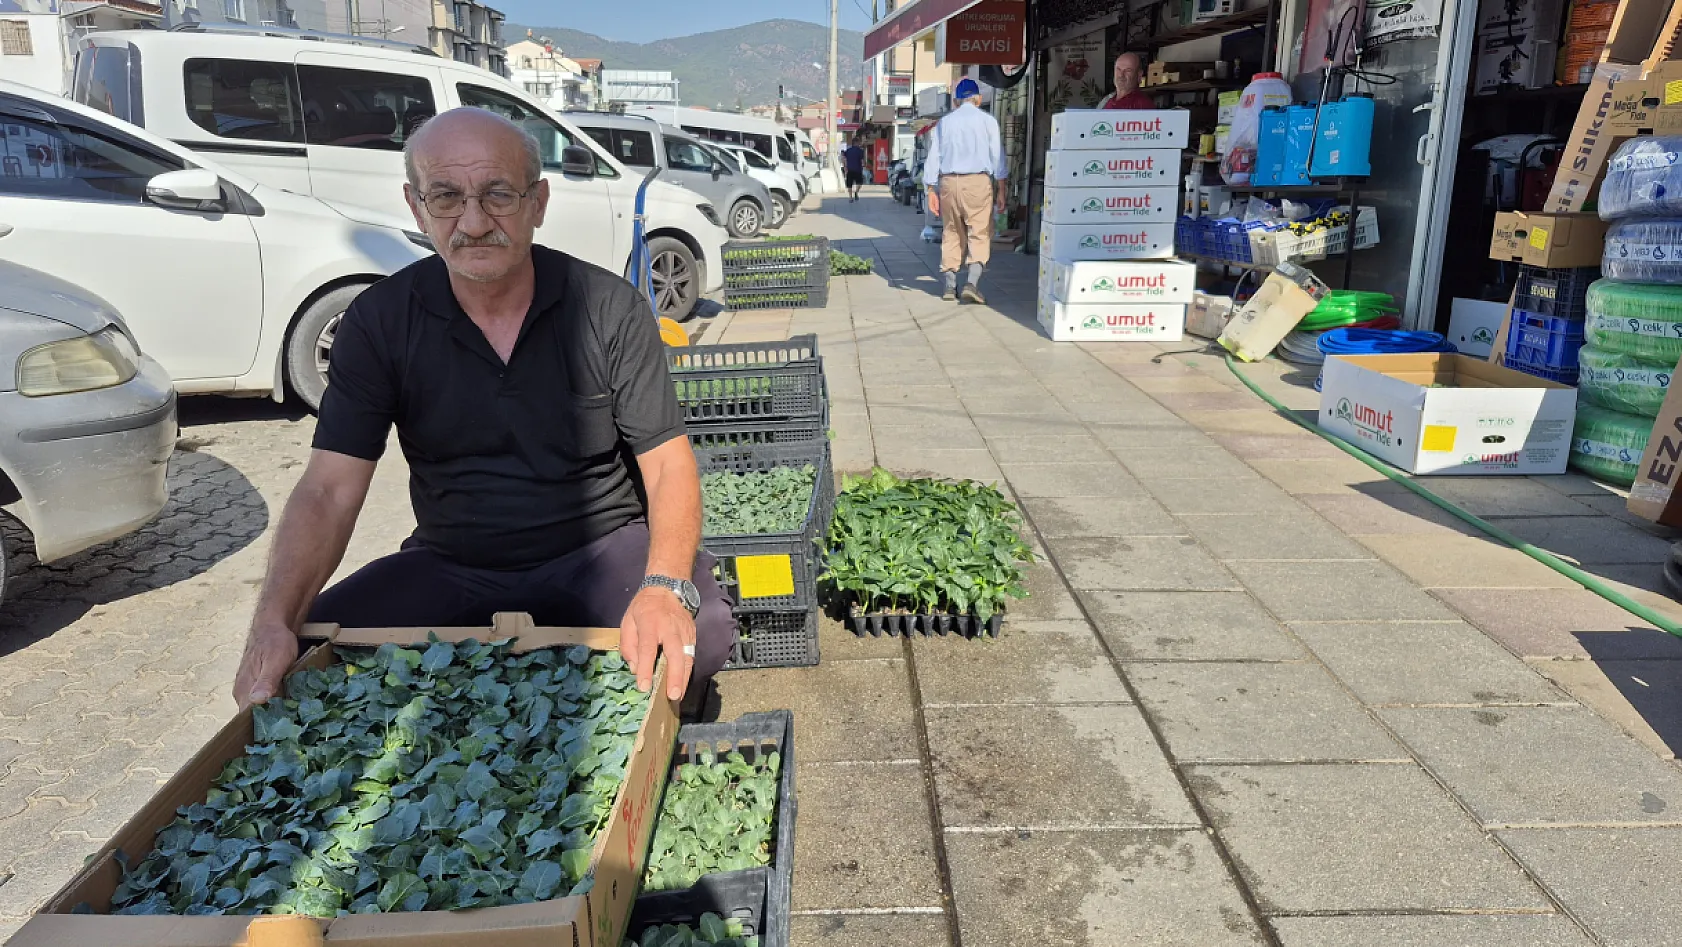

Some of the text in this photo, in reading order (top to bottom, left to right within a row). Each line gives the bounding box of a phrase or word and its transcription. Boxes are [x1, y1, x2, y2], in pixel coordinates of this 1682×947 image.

[979, 13, 1016, 22] KORUMA
[959, 37, 1011, 52] BAYİSİ
[1614, 100, 1638, 112] Mega
[1629, 112, 1647, 121] Fide
[1115, 117, 1162, 132] umut
[1143, 132, 1161, 140] fide
[1108, 156, 1154, 171] umut
[1135, 170, 1153, 179] fide
[1105, 194, 1152, 208] umut
[1133, 207, 1150, 216] fide
[1102, 231, 1148, 245] umut
[1129, 244, 1147, 252] fide
[1118, 273, 1166, 288] umut
[1146, 287, 1165, 296] fide
[1107, 312, 1155, 327] umut
[1136, 326, 1154, 334] fide
[1354, 402, 1394, 433] umut
[1376, 430, 1392, 447] fide
[1481, 451, 1520, 464] umut
